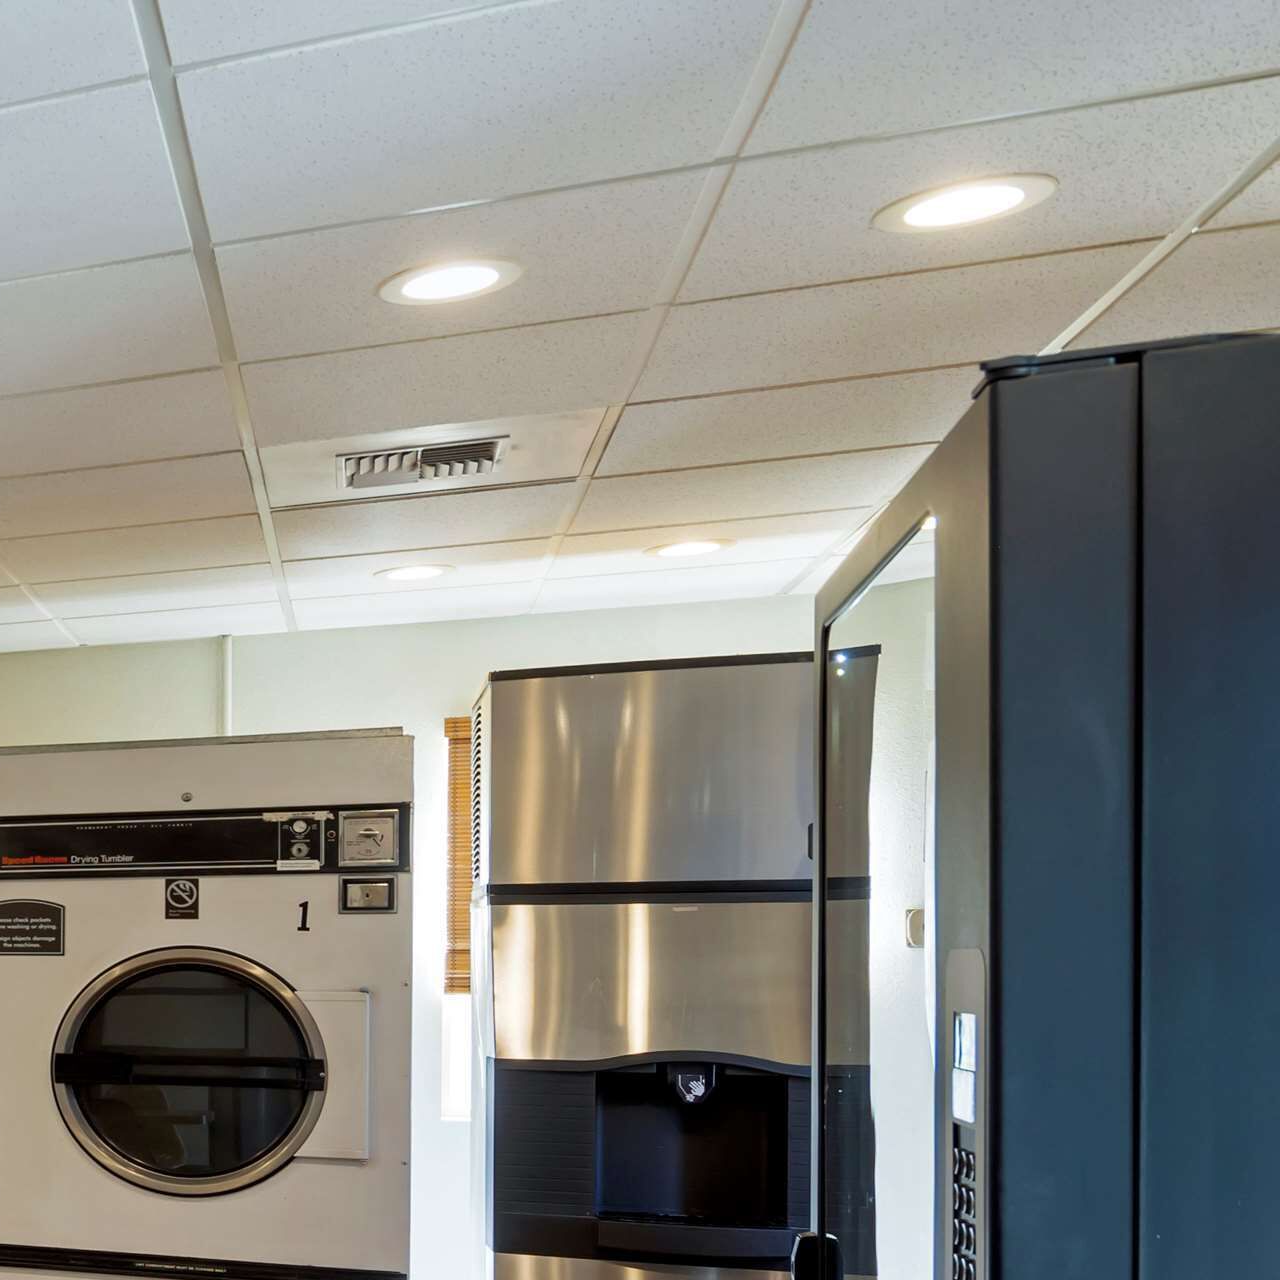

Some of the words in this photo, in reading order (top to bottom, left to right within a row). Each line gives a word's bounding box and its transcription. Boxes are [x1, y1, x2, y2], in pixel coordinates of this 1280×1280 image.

[70, 855, 99, 865] Drying
[101, 854, 134, 863] Tumbler
[297, 900, 311, 932] 1
